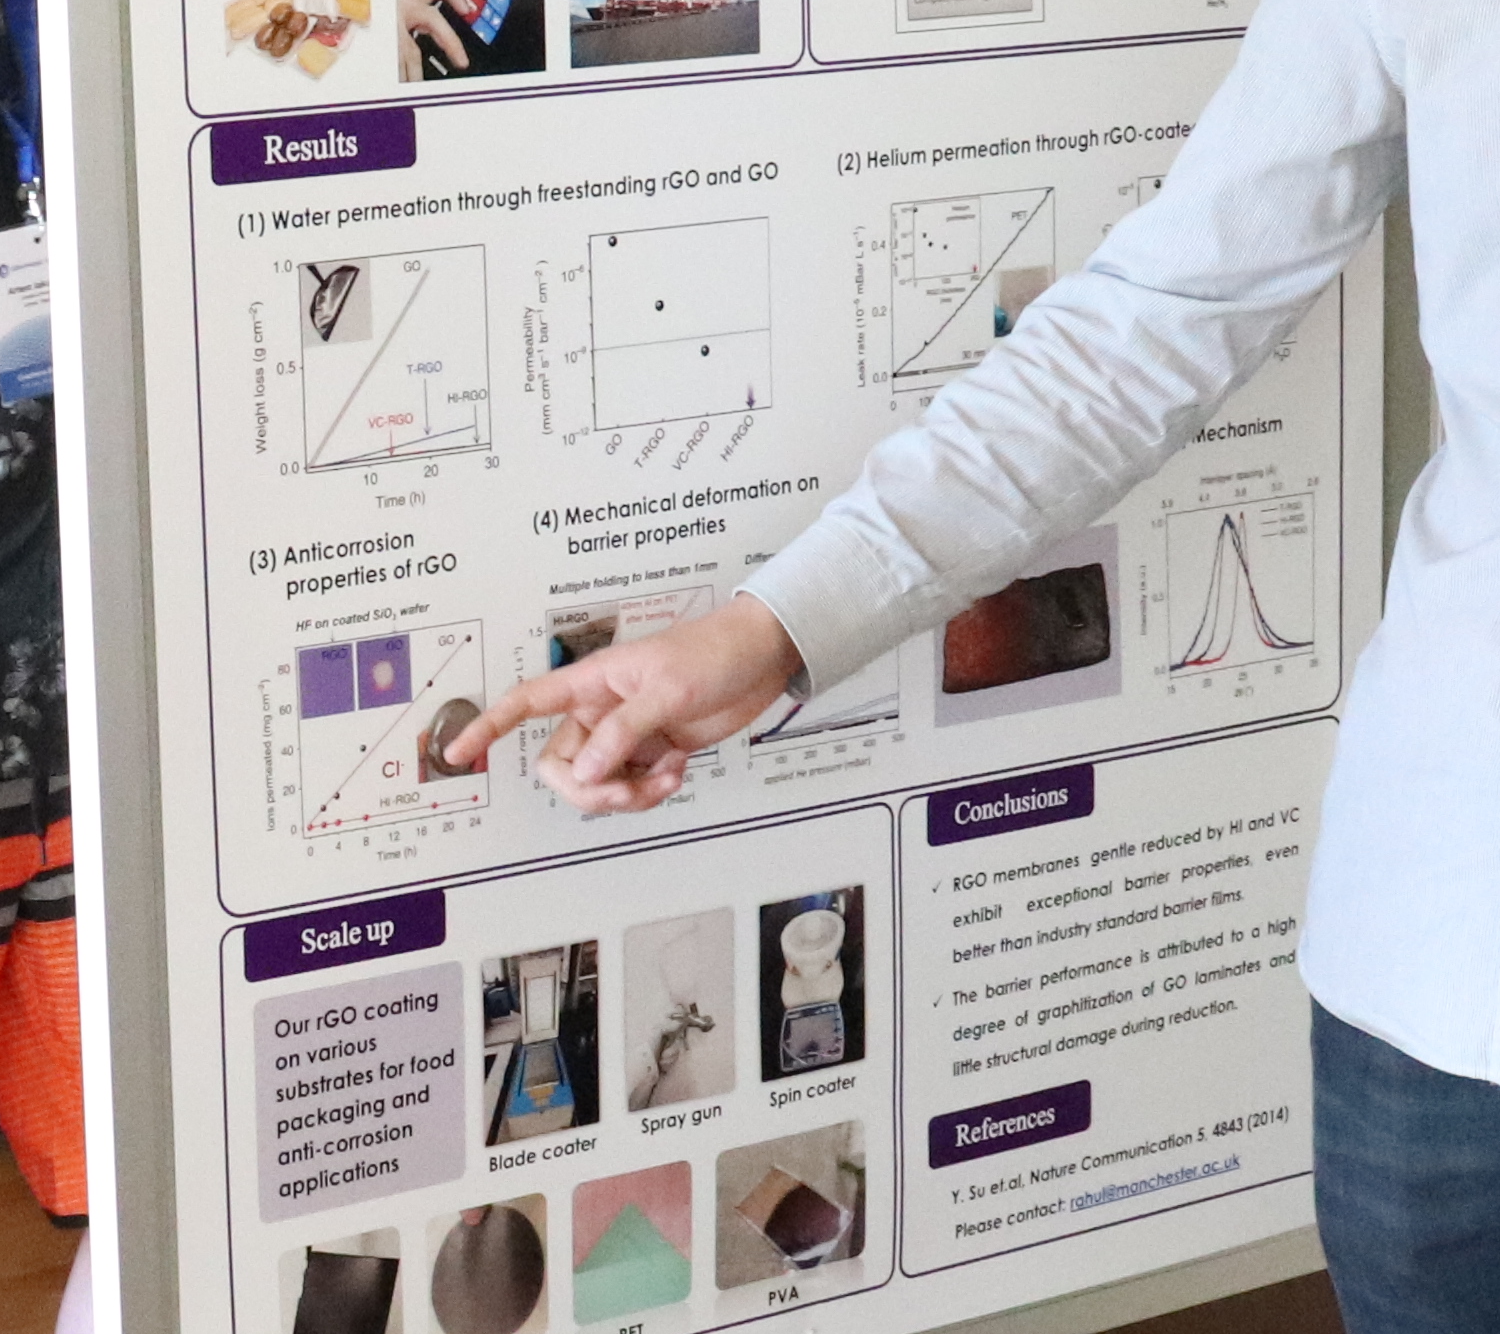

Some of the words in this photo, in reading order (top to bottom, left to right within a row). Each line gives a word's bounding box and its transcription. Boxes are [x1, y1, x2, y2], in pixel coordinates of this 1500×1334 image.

[263, 129, 358, 165] Results
[837, 152, 862, 175] (2)
[867, 144, 928, 169] Helium
[932, 136, 1033, 167] permeation
[1036, 129, 1100, 154] through
[1104, 121, 1196, 145] rGO-coate
[238, 212, 265, 239] (1)
[272, 208, 330, 230] Water
[338, 196, 451, 228] permeation
[458, 186, 532, 211] through
[538, 175, 656, 203] freestanding
[662, 169, 700, 190] rGO
[706, 165, 741, 186] and
[748, 162, 778, 182] GO
[403, 260, 421, 273] GO
[375, 495, 406, 508] Time
[409, 491, 426, 507] (h)
[533, 509, 558, 535] (4)
[565, 492, 676, 526] Mechanical
[682, 479, 791, 509] deformation
[797, 476, 819, 492] on
[250, 548, 276, 575] (3)
[284, 532, 414, 565] Anticorrosion
[568, 531, 628, 555] barrier
[635, 517, 726, 549] properties
[287, 566, 387, 600] properties
[393, 558, 411, 579] of
[418, 553, 457, 576] rGO
[954, 788, 1068, 825] Conclusions
[300, 922, 364, 955] Scale
[367, 919, 396, 948] up
[770, 1088, 802, 1109] Spin
[806, 1076, 856, 1098] coater
[641, 1113, 686, 1135] Spray
[692, 1105, 722, 1126] gun
[955, 1108, 1055, 1147] References
[489, 1150, 536, 1172] Blade
[542, 1138, 597, 1160] coater
[969, 1185, 985, 1200] Su
[1030, 1163, 1076, 1184] Nature
[1081, 1134, 1193, 1171] Communication
[1212, 1117, 1243, 1137] 4843
[1247, 1106, 1289, 1132] (2014)
[769, 1286, 799, 1306] PVA
